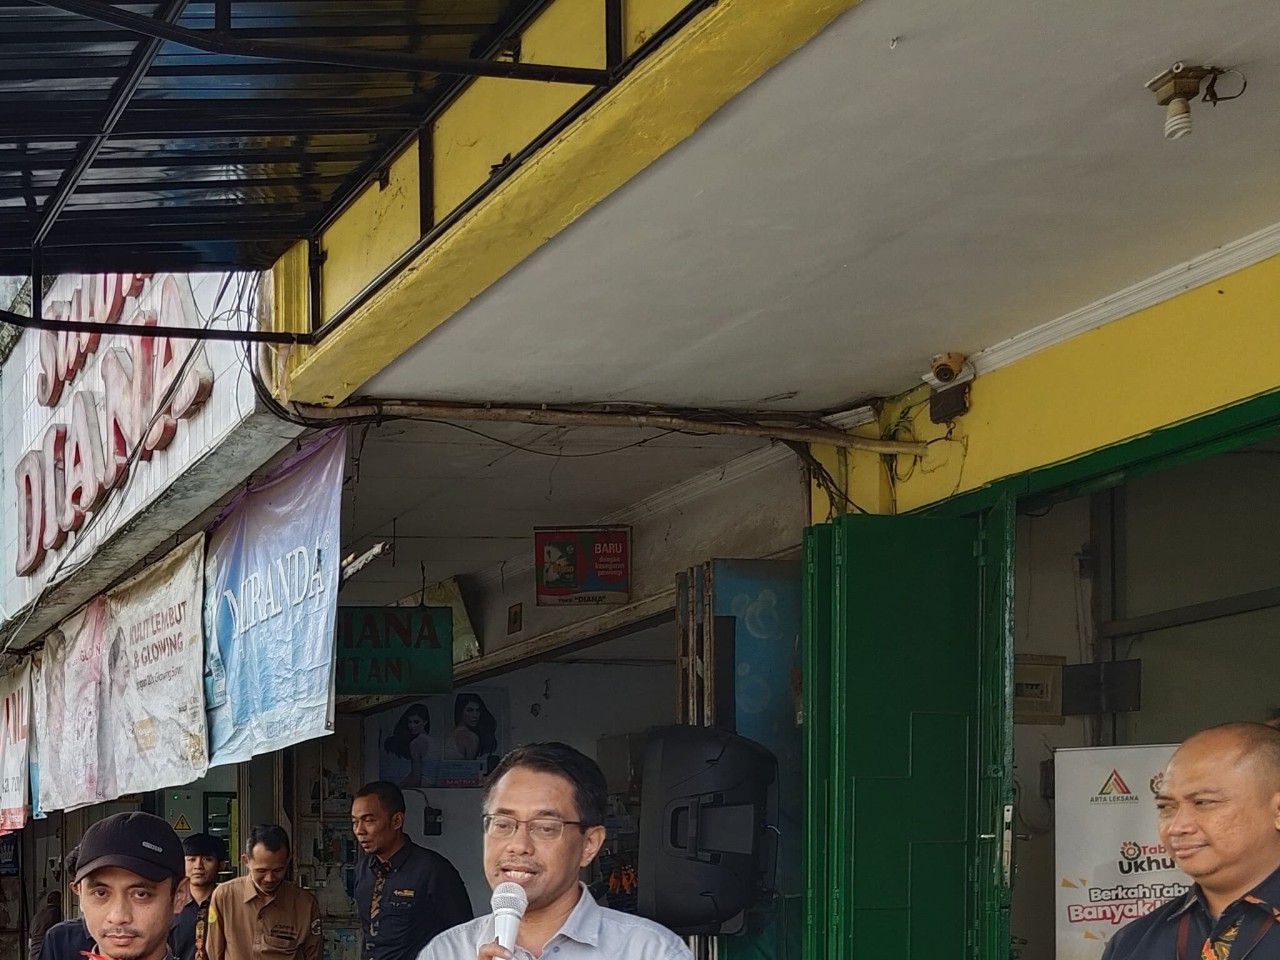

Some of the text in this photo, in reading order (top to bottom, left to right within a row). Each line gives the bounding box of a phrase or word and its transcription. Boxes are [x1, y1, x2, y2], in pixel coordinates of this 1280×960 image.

[15, 275, 214, 577] DIANA
[594, 543, 623, 554] BARU
[129, 600, 188, 646] KULIT LEMBUT
[342, 612, 442, 649] IANA
[141, 631, 184, 668] GLOWING
[1141, 845, 1167, 855] Tab
[1119, 856, 1176, 875] Ukhu
[1089, 884, 1152, 902] Berkah
[1068, 900, 1154, 925] Banyak
